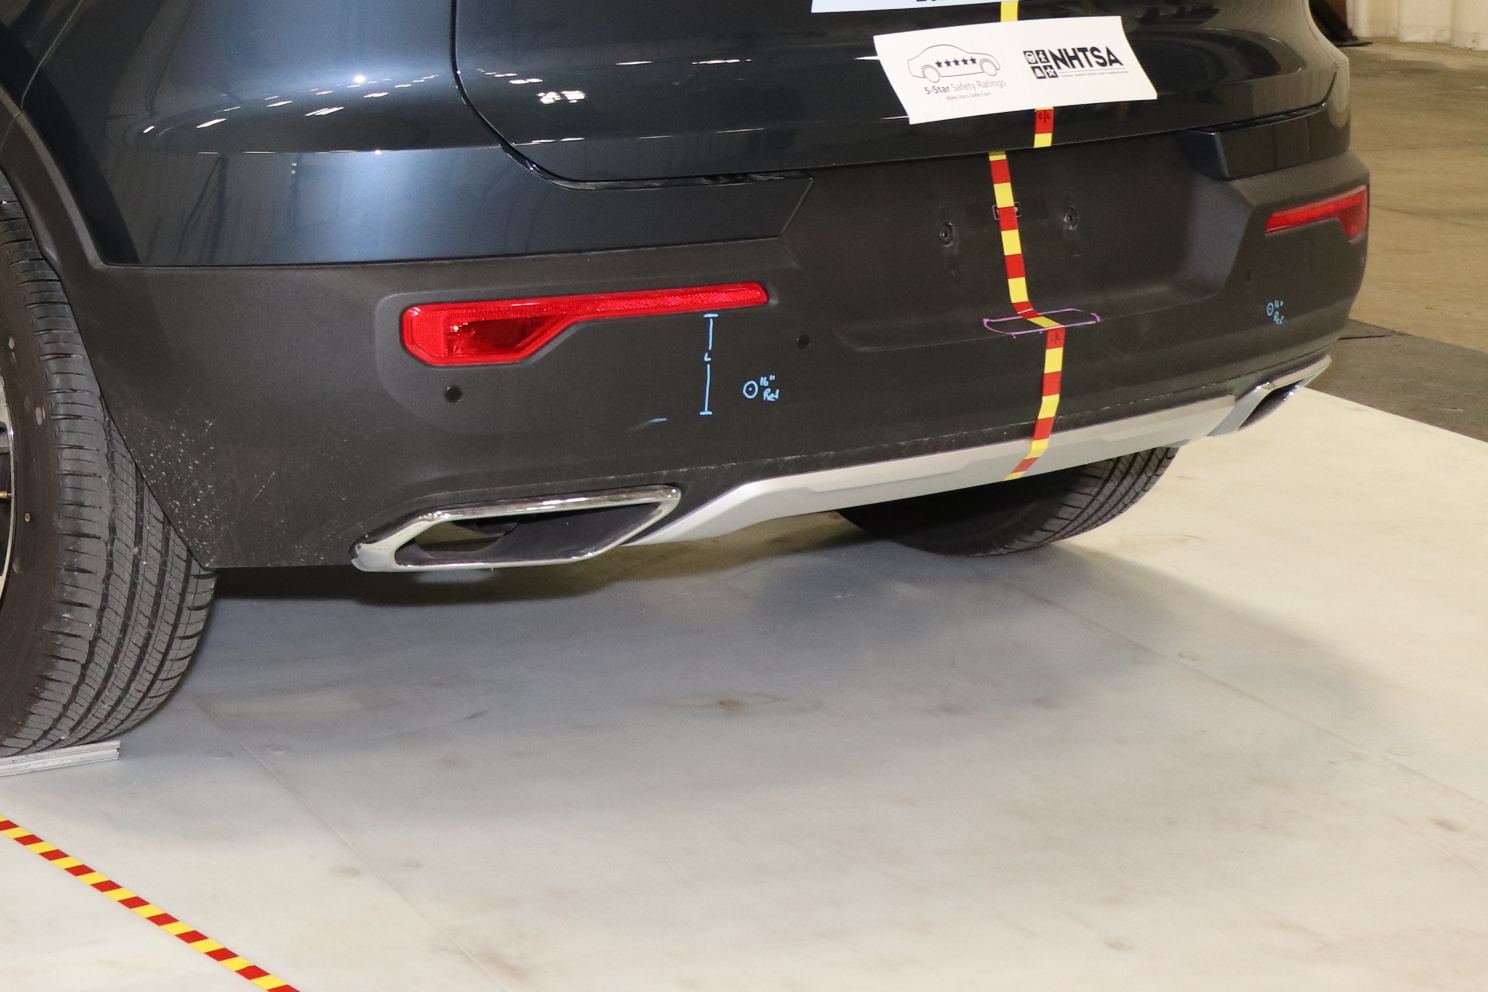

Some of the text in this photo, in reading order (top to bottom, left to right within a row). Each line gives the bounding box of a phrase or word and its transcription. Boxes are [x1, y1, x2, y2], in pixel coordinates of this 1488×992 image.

[1048, 46, 1124, 70] NHTSA
[924, 78, 1007, 96] 5-Star Safety Ratings
